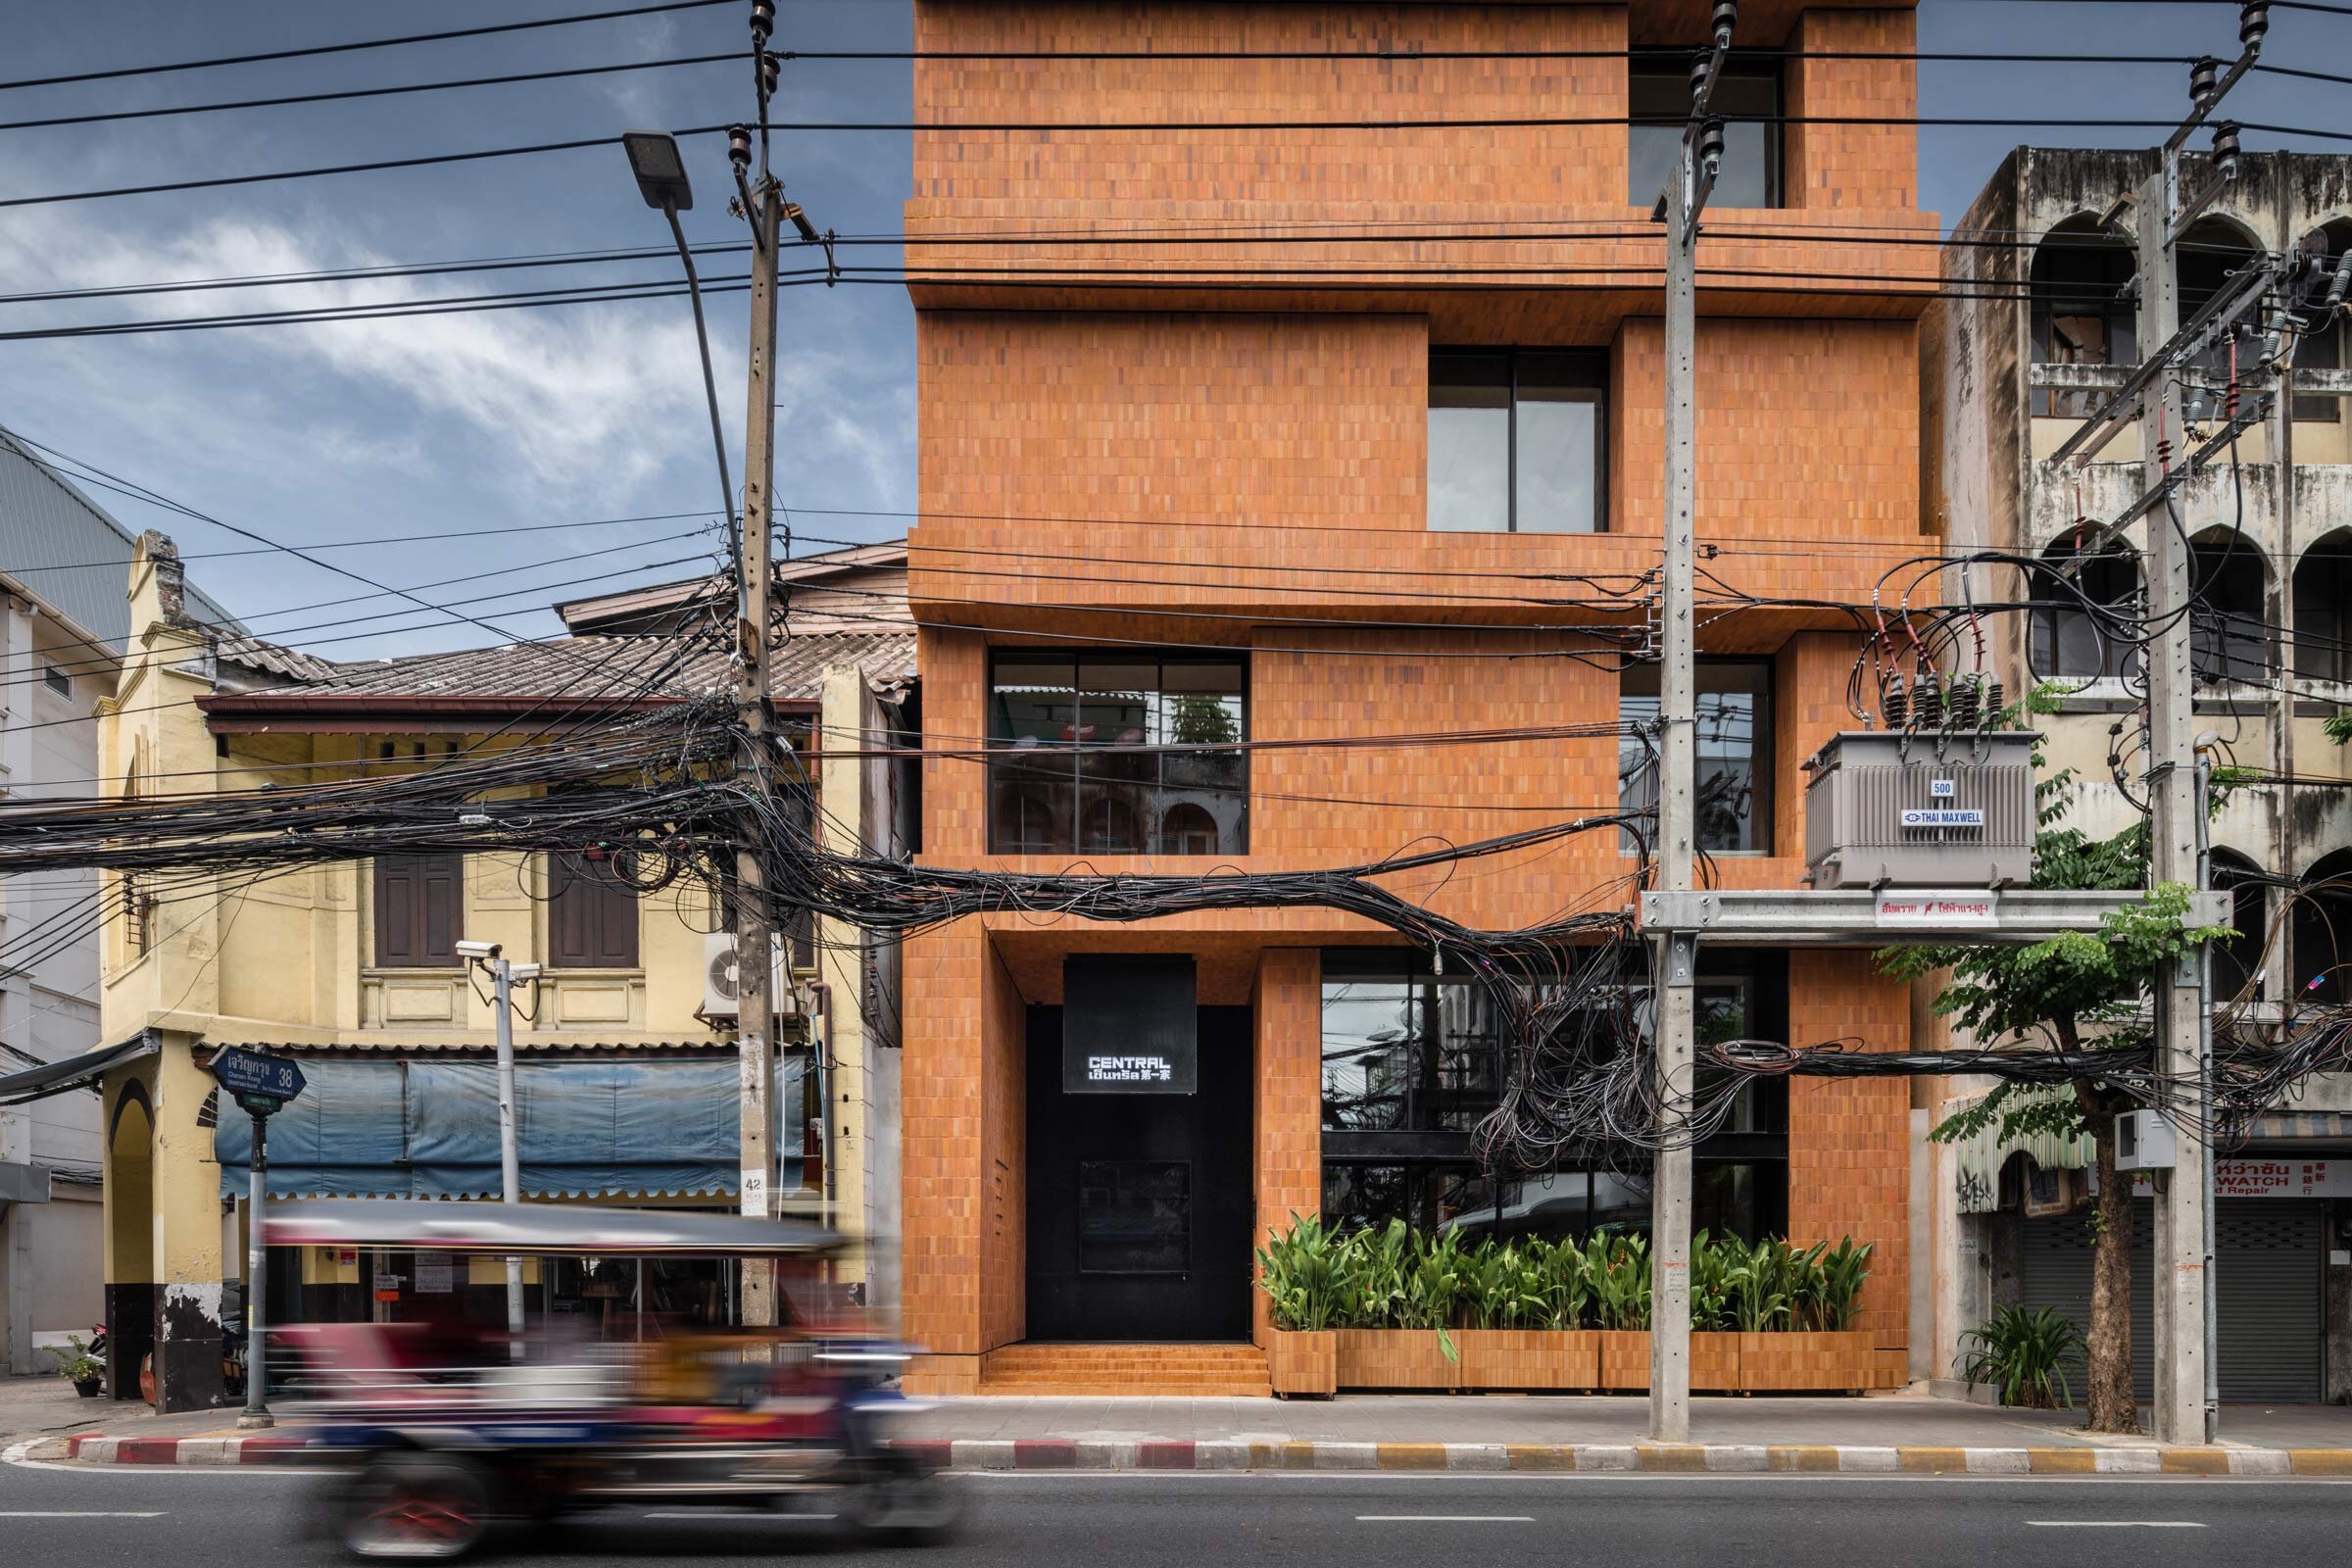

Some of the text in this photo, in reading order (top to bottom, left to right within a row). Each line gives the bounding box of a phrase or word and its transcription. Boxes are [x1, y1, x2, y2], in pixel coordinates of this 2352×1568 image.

[1934, 783, 1951, 794] 500
[1921, 812, 1982, 823] THAI MAXWELL
[1882, 902, 1988, 916] อันตราย ไฟฟ้าแรงสูง
[1088, 1056, 1171, 1069] CENTRAL
[227, 1054, 270, 1078] เจริญกรุง
[278, 1067, 293, 1088] 38
[746, 1179, 760, 1191] 42
[2216, 1177, 2289, 1186] WATCH
[2228, 1187, 2271, 1196] Repair
